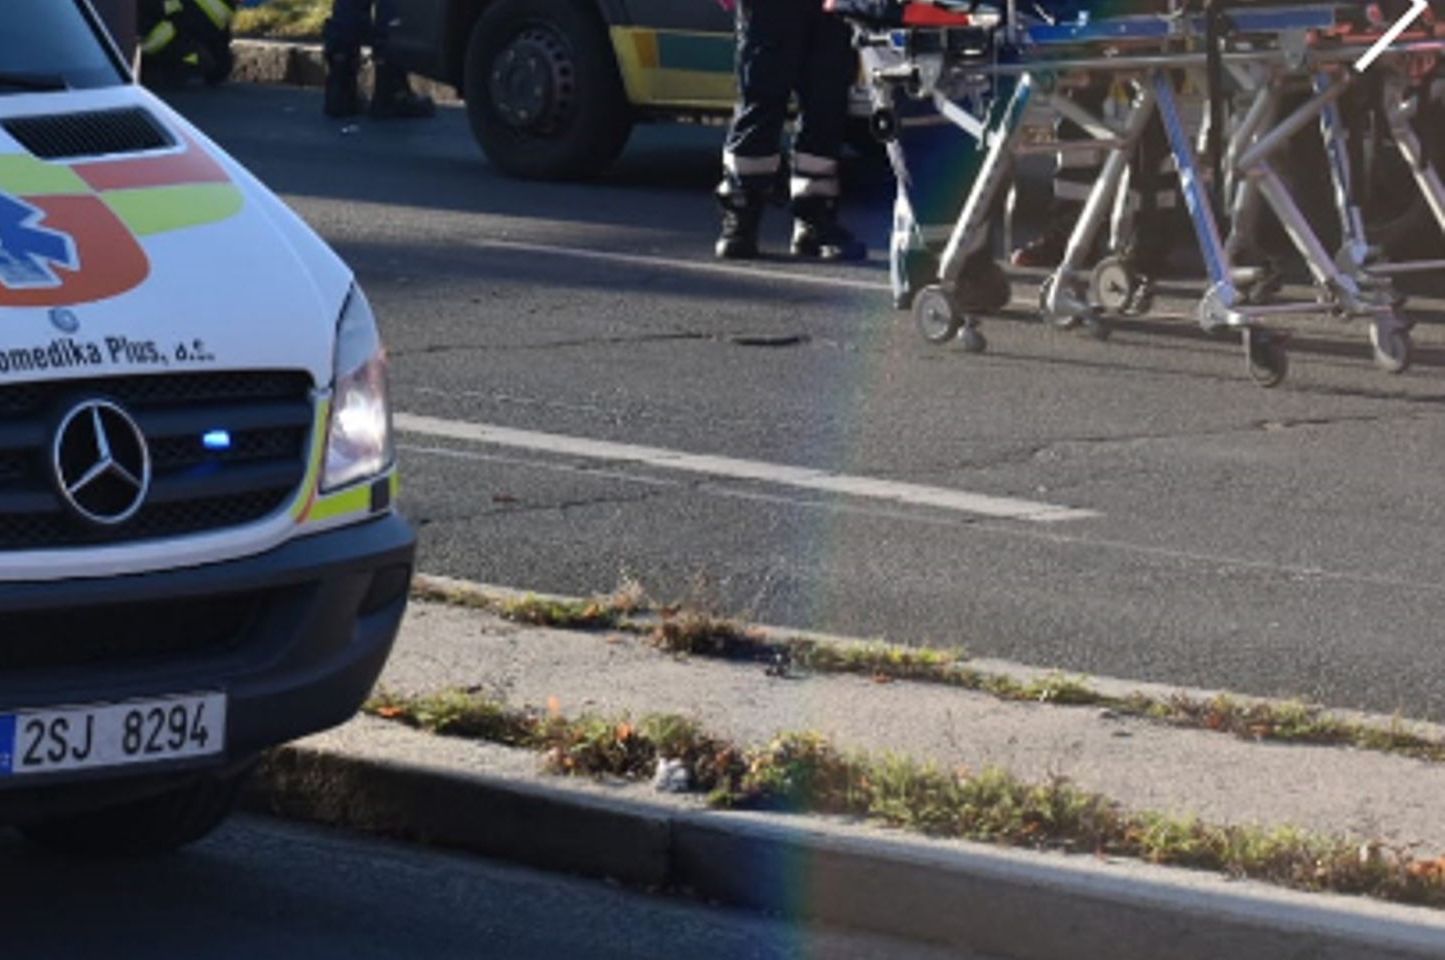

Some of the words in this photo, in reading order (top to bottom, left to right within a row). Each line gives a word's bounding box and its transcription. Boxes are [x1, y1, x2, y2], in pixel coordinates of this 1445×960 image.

[105, 336, 169, 365] Plus,
[22, 714, 94, 766] 2SJ
[122, 703, 210, 756] 8294
